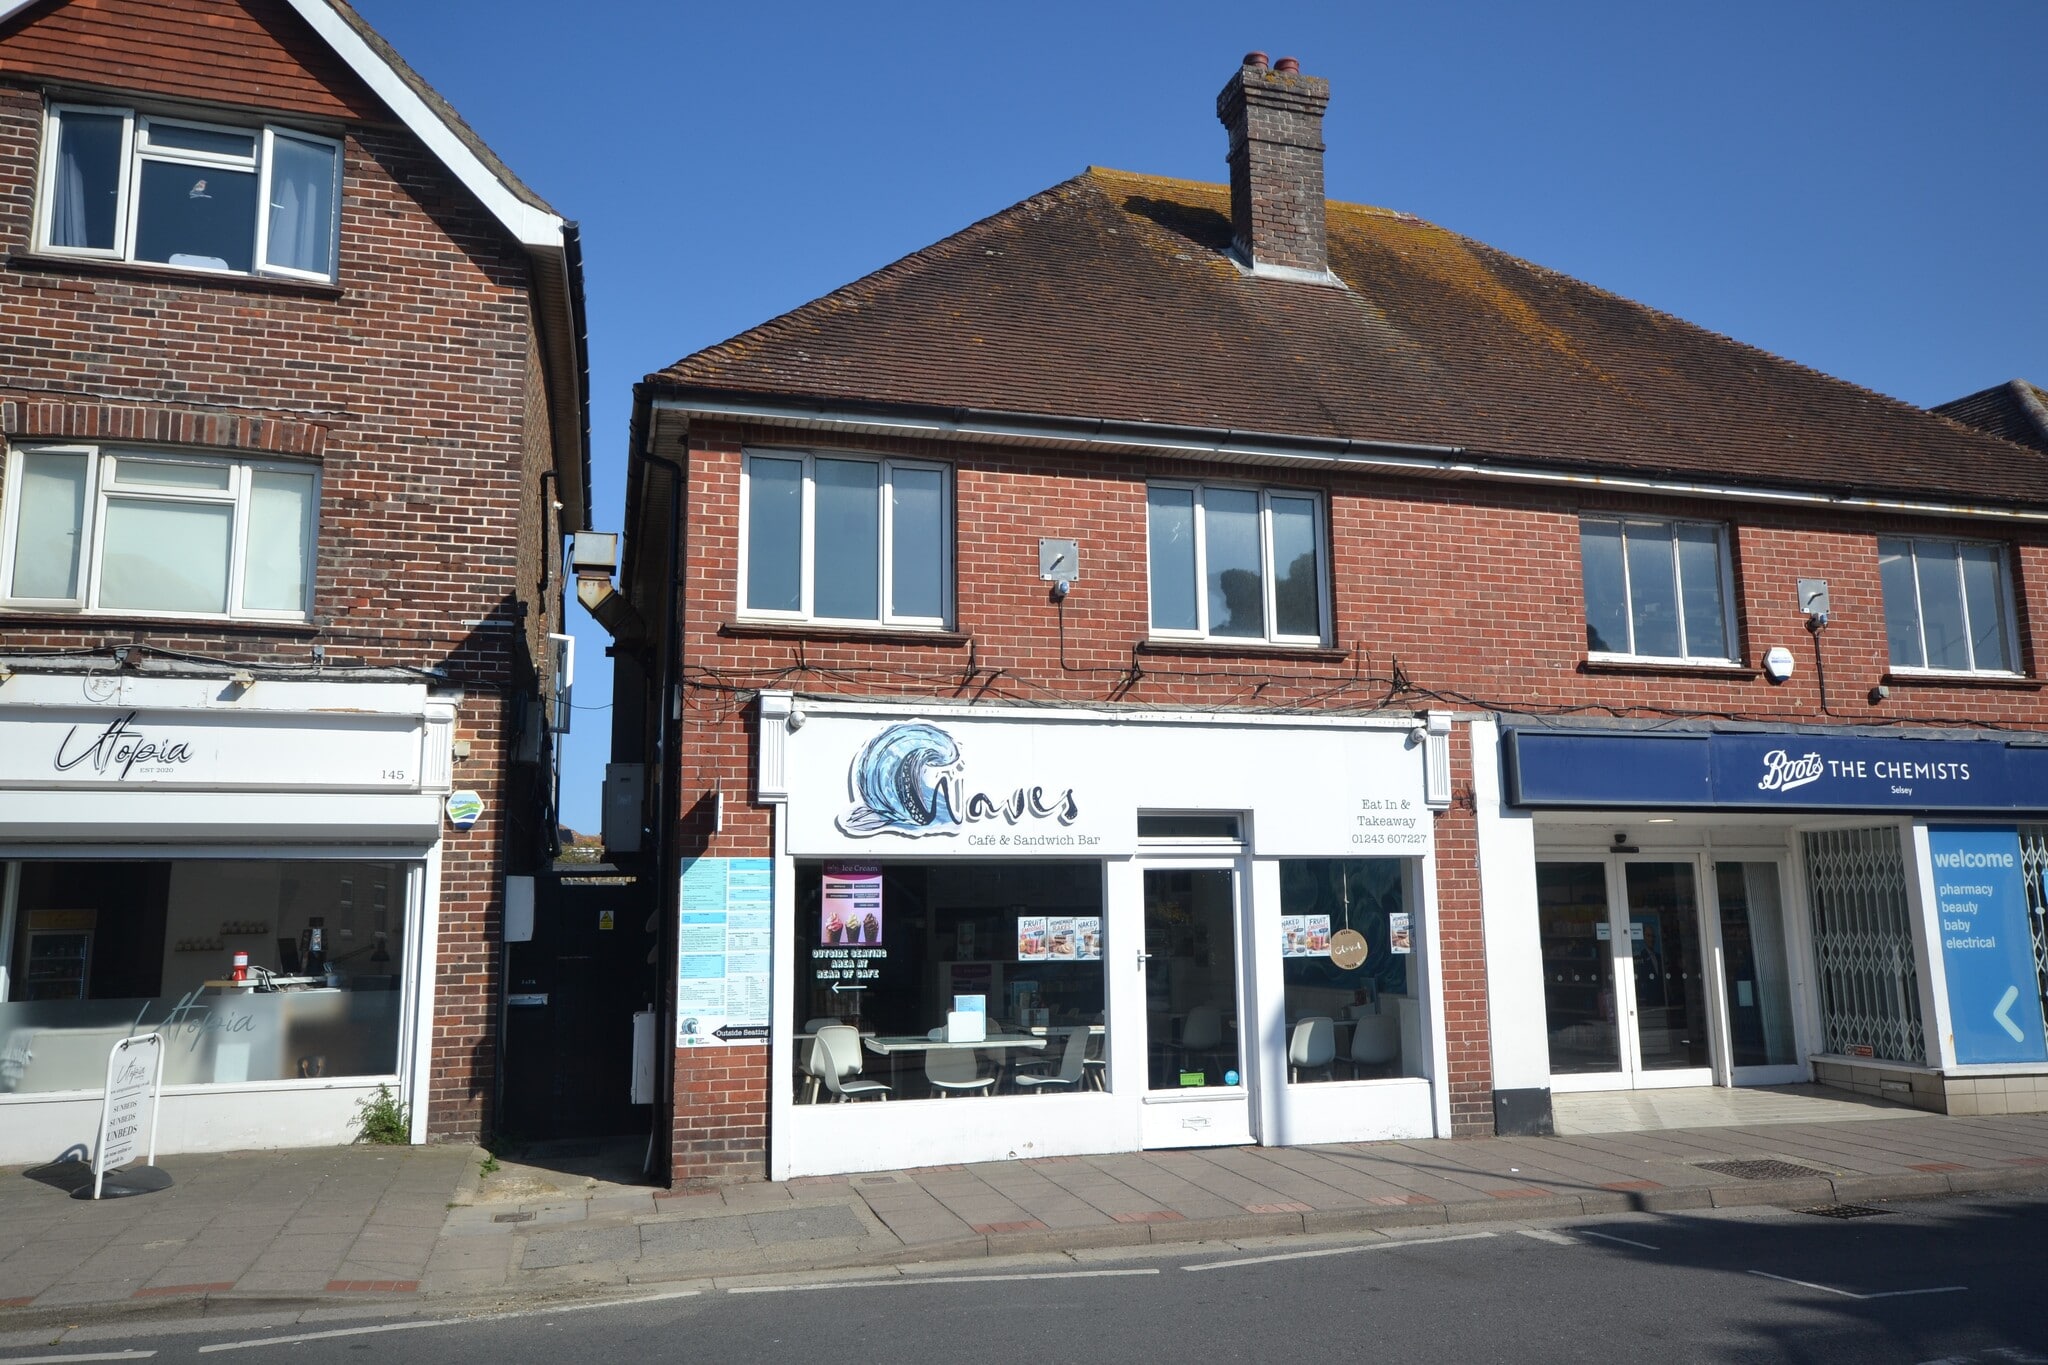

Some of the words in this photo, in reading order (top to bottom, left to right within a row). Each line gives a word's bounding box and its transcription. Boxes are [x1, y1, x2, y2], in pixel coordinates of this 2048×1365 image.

[55, 711, 193, 780] Utopia
[382, 769, 405, 780] 145
[1758, 749, 1823, 792] Boots
[1828, 760, 1867, 778] THE
[1874, 761, 1970, 780] CHEMISTS
[896, 750, 1079, 826] Waves
[1891, 785, 1913, 796] Selsey
[1362, 799, 1382, 810] Eat
[1385, 799, 1397, 810] In
[1400, 799, 1411, 810] &
[1357, 815, 1416, 828] Takeaway
[968, 834, 996, 846] Café
[999, 835, 1011, 846] &
[1013, 834, 1074, 846] Sandwich
[1078, 834, 1101, 846] Bar
[1351, 834, 1385, 844] 01243
[1387, 834, 1427, 844] 607227
[1934, 849, 2014, 868] welcome
[842, 864, 853, 872] Ice
[854, 864, 878, 872] Cream
[1940, 883, 1993, 897] pharmacy
[1941, 901, 1978, 915] beauty
[1023, 919, 1042, 928] FRUIT
[1077, 920, 1097, 929] NAKED
[1309, 917, 1326, 925] FRUIT
[1944, 919, 1970, 933] baby
[1946, 936, 1995, 949] electrical
[812, 949, 849, 958] OUTSIDE
[851, 949, 888, 958] SEATING
[831, 959, 855, 969] AREA
[857, 959, 868, 968] AT
[816, 970, 840, 979] REAR
[842, 970, 854, 979] OF
[743, 1028, 768, 1037] Seating
[113, 1100, 138, 1113] SUNBEDS
[109, 1113, 136, 1127] SUNBEDS
[106, 1124, 138, 1142] UNBEDS
